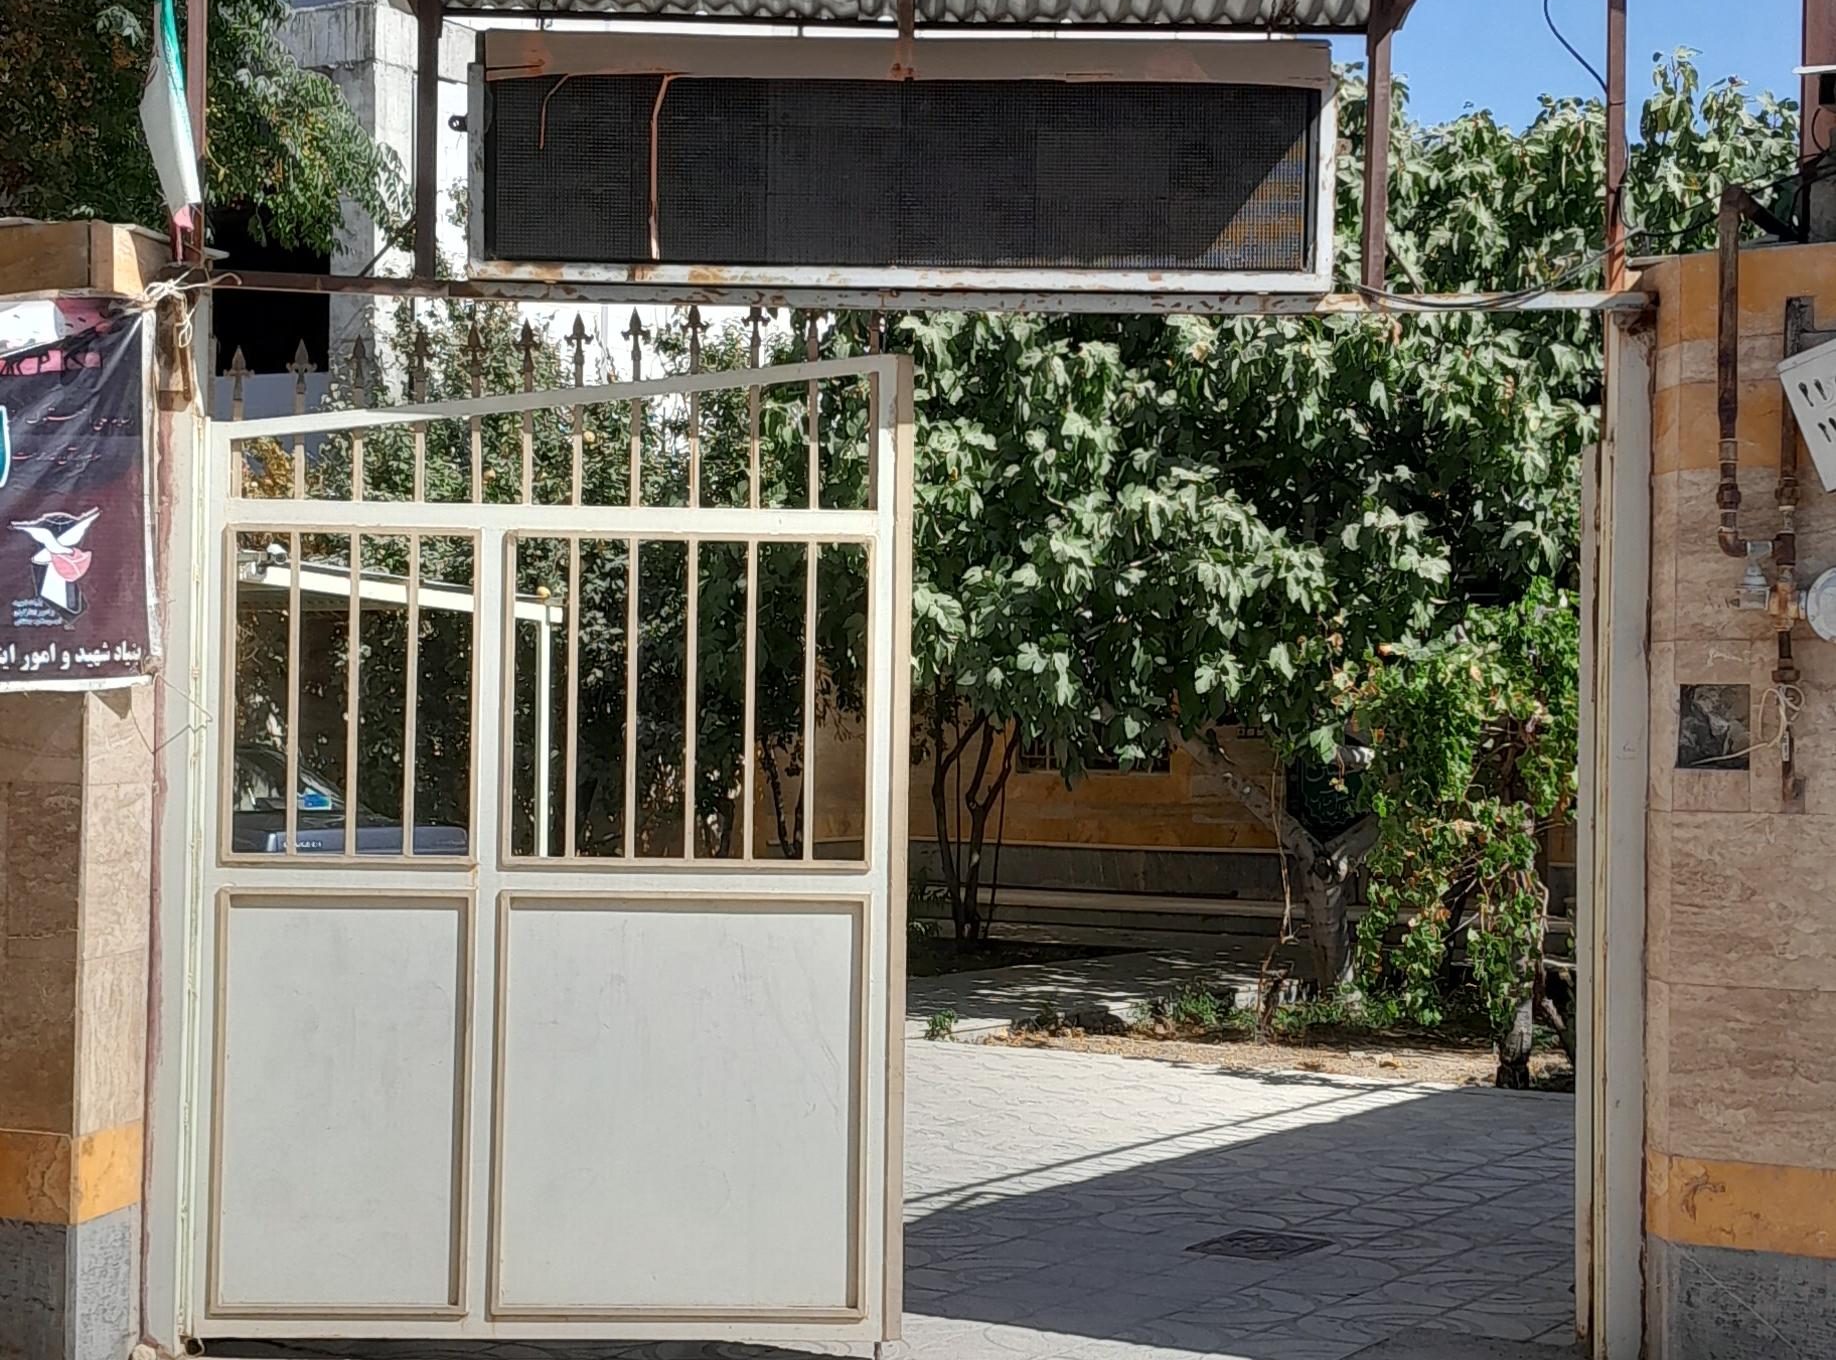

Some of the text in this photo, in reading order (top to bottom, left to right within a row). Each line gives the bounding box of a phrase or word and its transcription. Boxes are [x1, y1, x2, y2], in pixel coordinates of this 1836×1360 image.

[19, 642, 56, 671] امور
[60, 650, 71, 671] و
[75, 641, 111, 667] شهید
[113, 640, 142, 666] بنیاد
